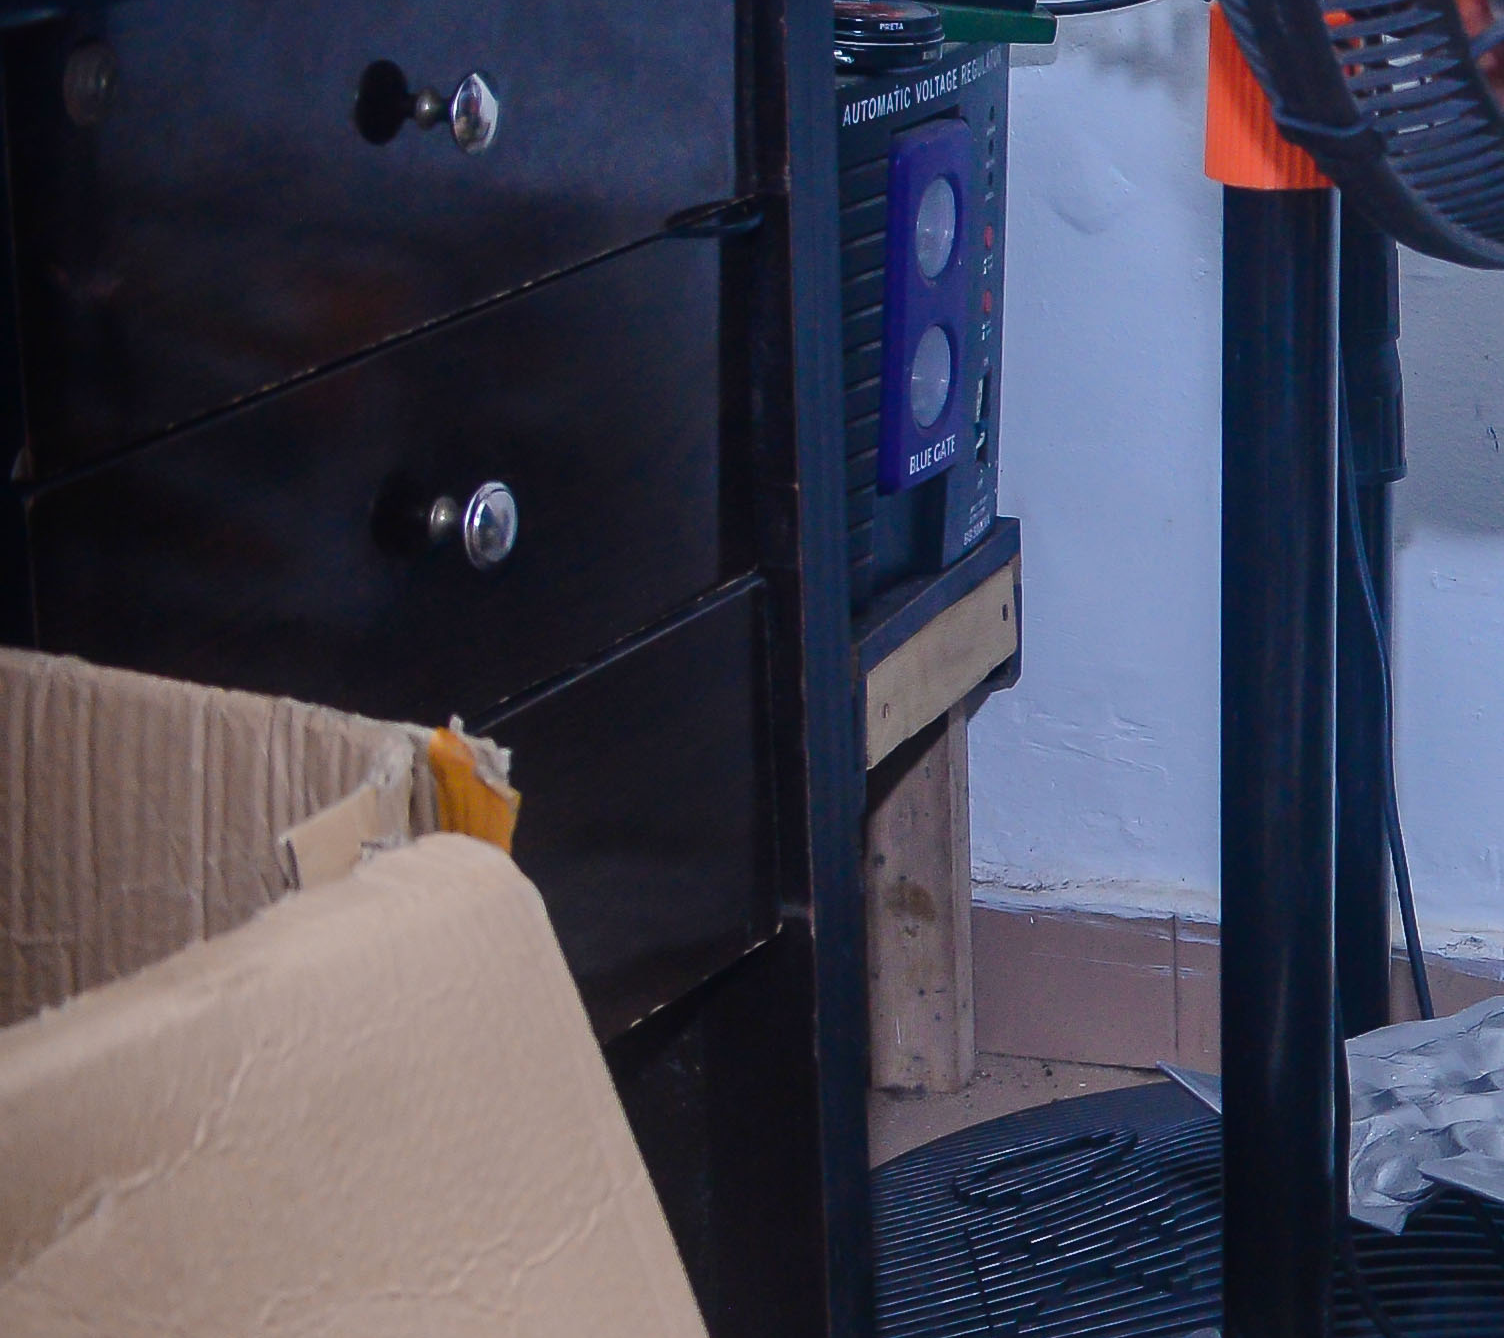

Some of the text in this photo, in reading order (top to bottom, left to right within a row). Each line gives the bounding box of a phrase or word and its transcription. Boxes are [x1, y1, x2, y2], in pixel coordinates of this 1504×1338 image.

[842, 85, 911, 128] AUTOMATIC
[915, 68, 958, 104] VOLTAGE
[909, 434, 956, 476] BLUE GATE
